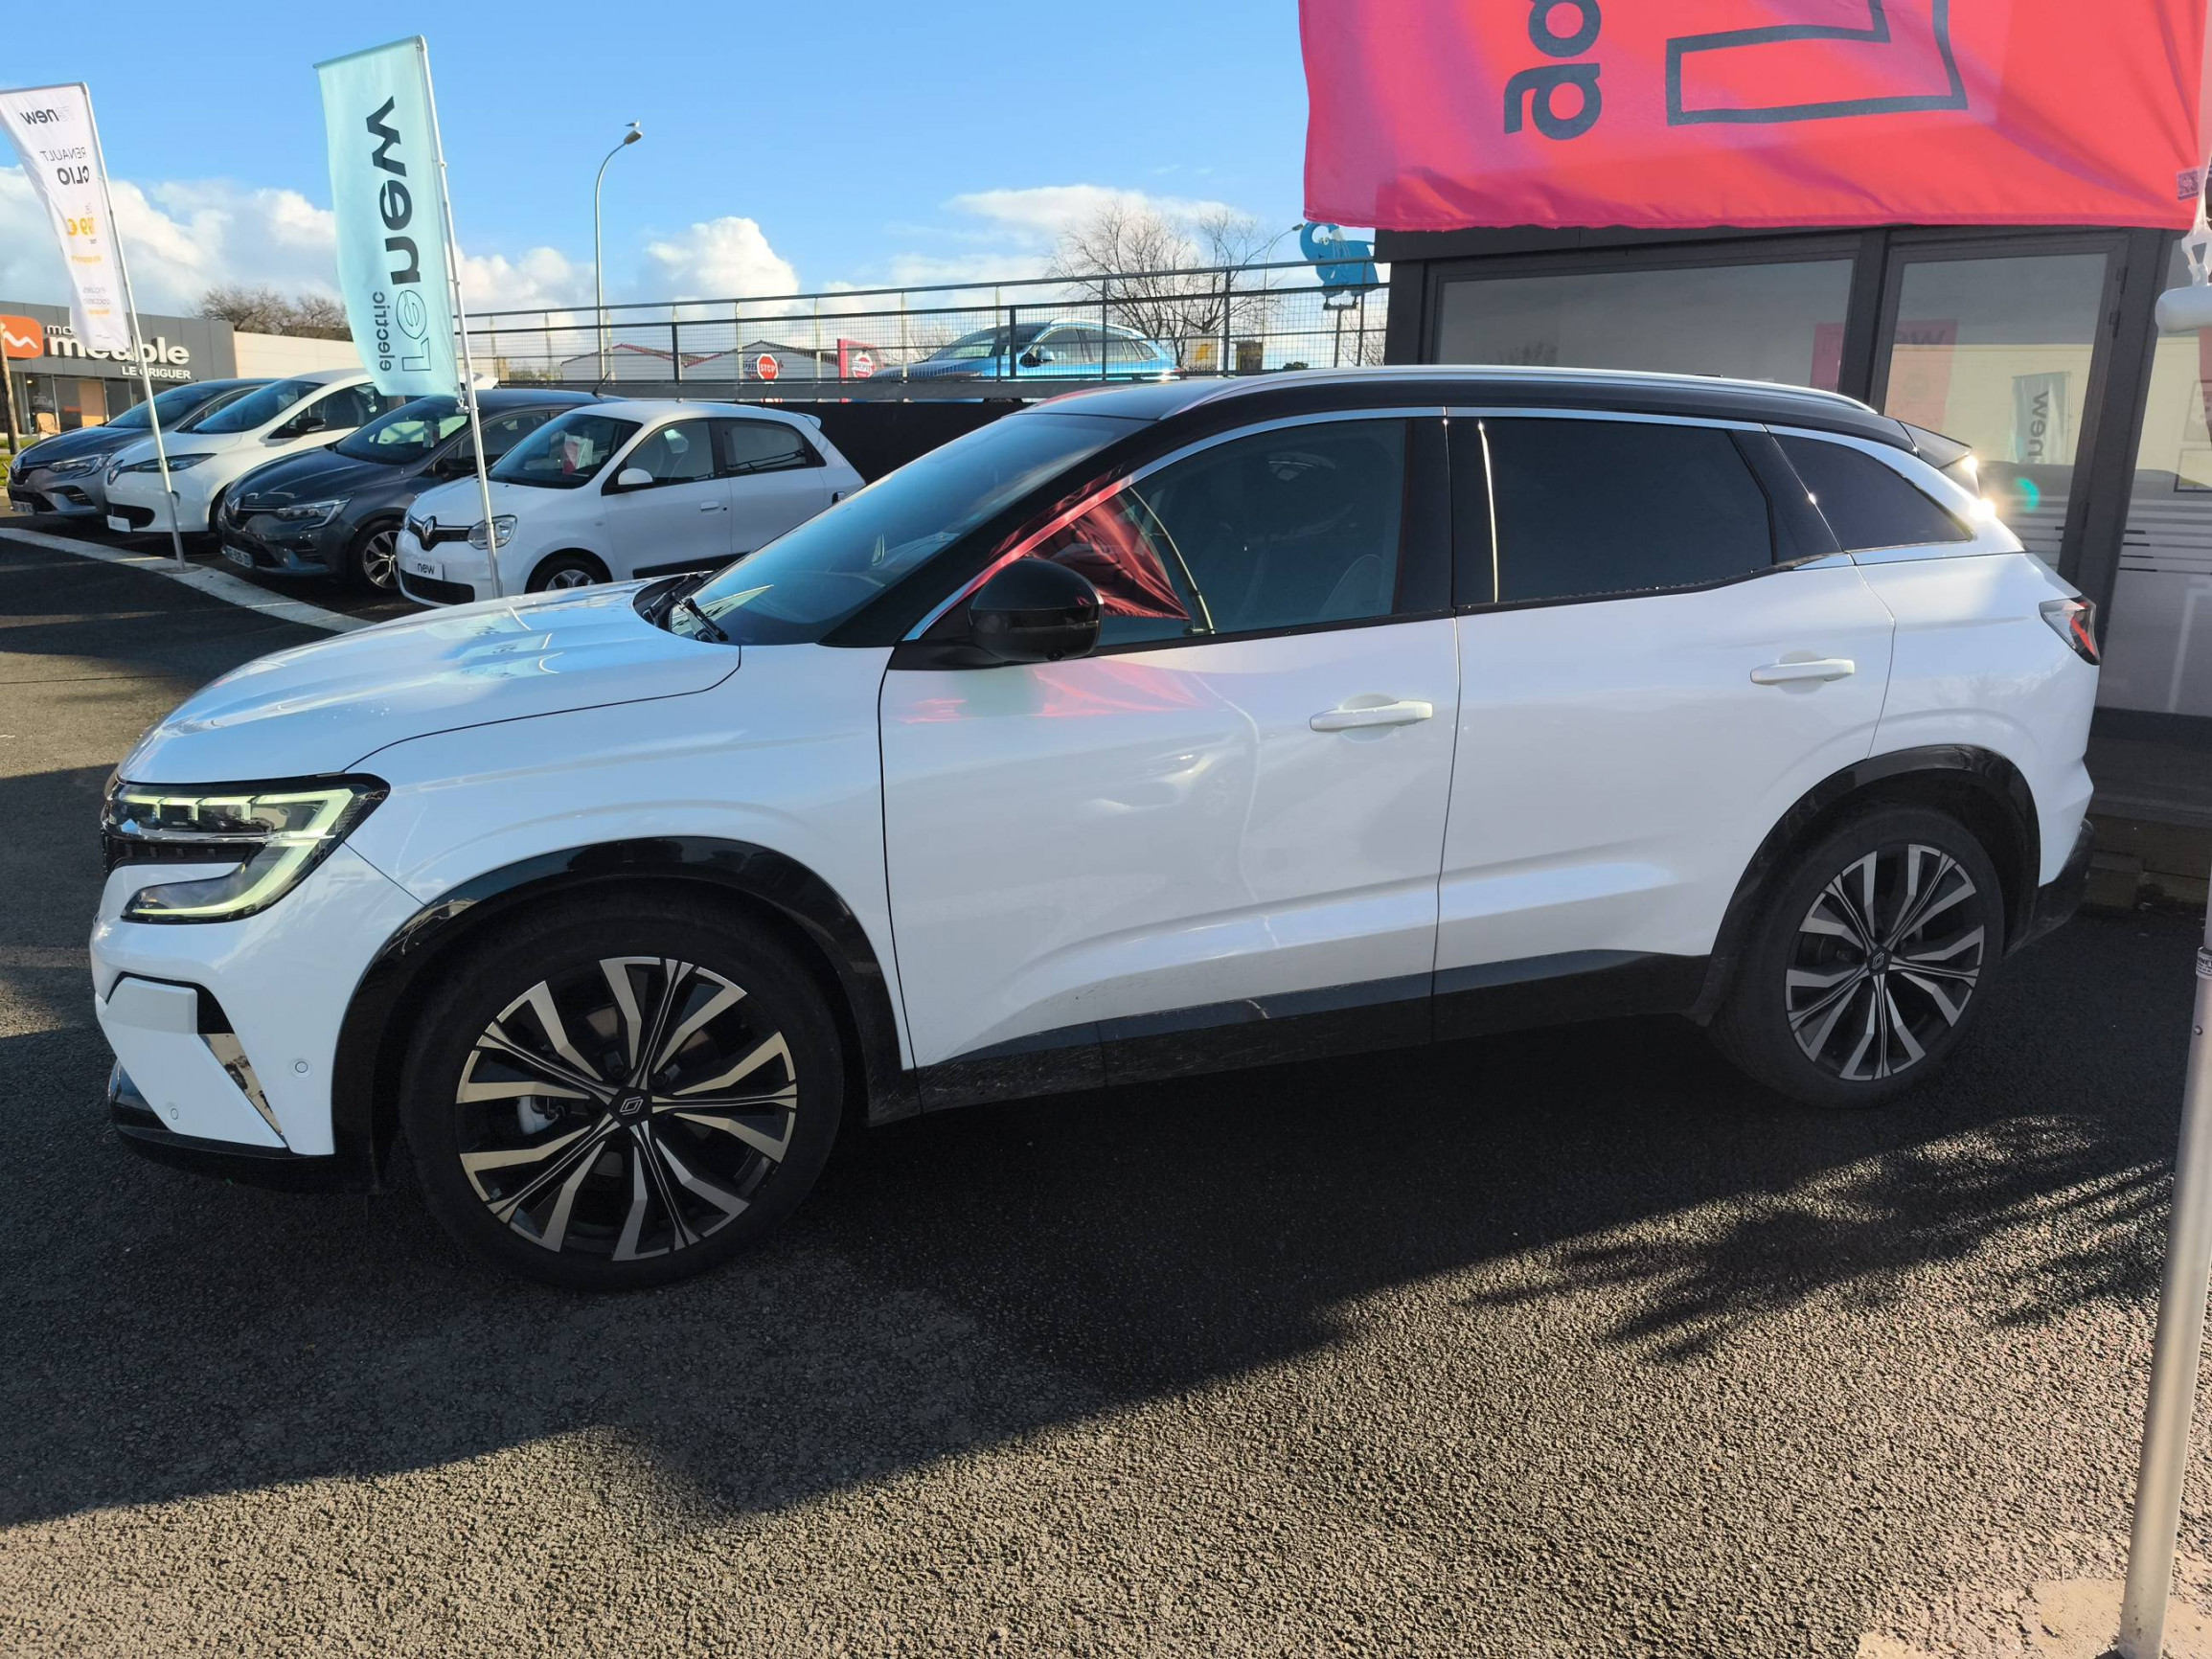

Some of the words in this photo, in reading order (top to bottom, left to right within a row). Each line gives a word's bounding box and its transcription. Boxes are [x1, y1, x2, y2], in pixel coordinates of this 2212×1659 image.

[122, 366, 137, 375] LE
[139, 368, 192, 379] RIGUER
[760, 364, 776, 373] STOP
[417, 562, 435, 575] new
